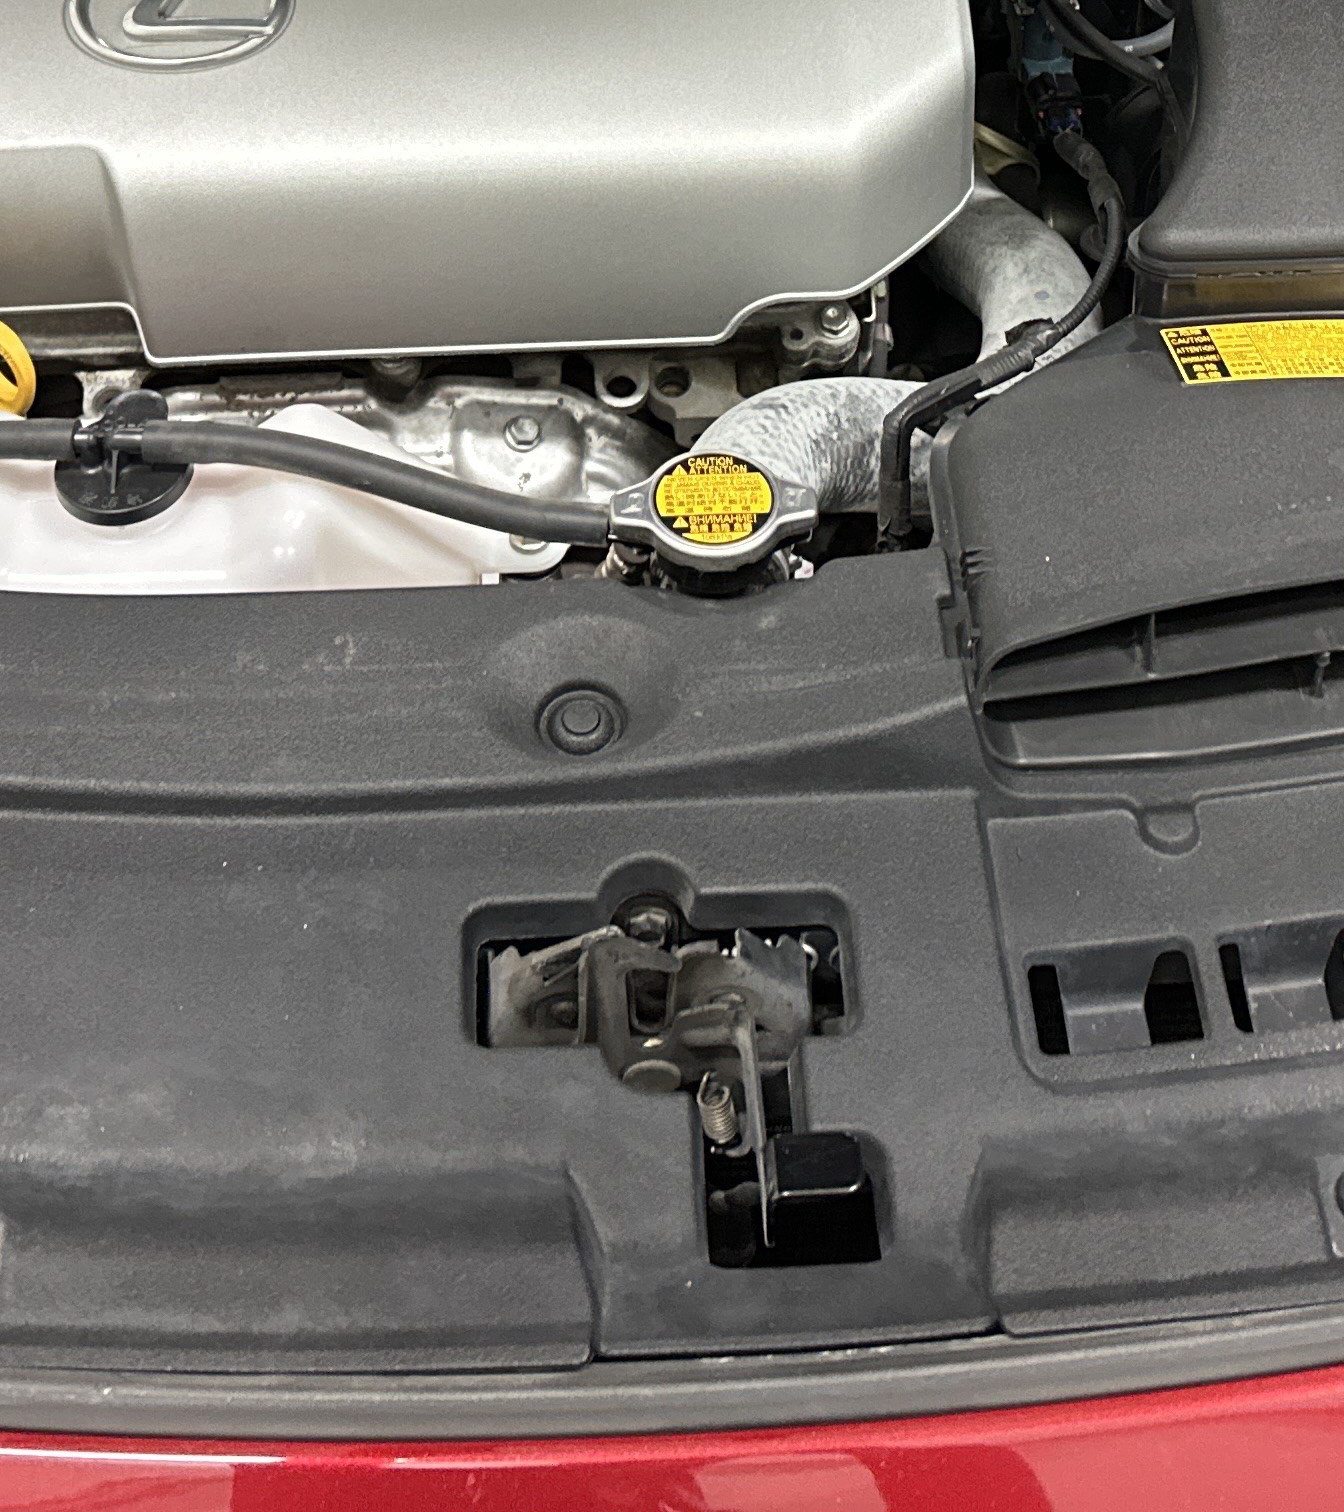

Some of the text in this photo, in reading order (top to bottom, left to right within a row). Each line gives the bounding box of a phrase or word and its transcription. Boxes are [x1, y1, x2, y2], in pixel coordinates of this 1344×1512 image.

[1171, 335, 1211, 346] CAUTION
[1176, 344, 1216, 355] ATTENTION
[687, 457, 734, 466] CAUTION
[689, 465, 747, 474] ATTENTION
[688, 513, 757, 524] ВНИМАНИЕ!
